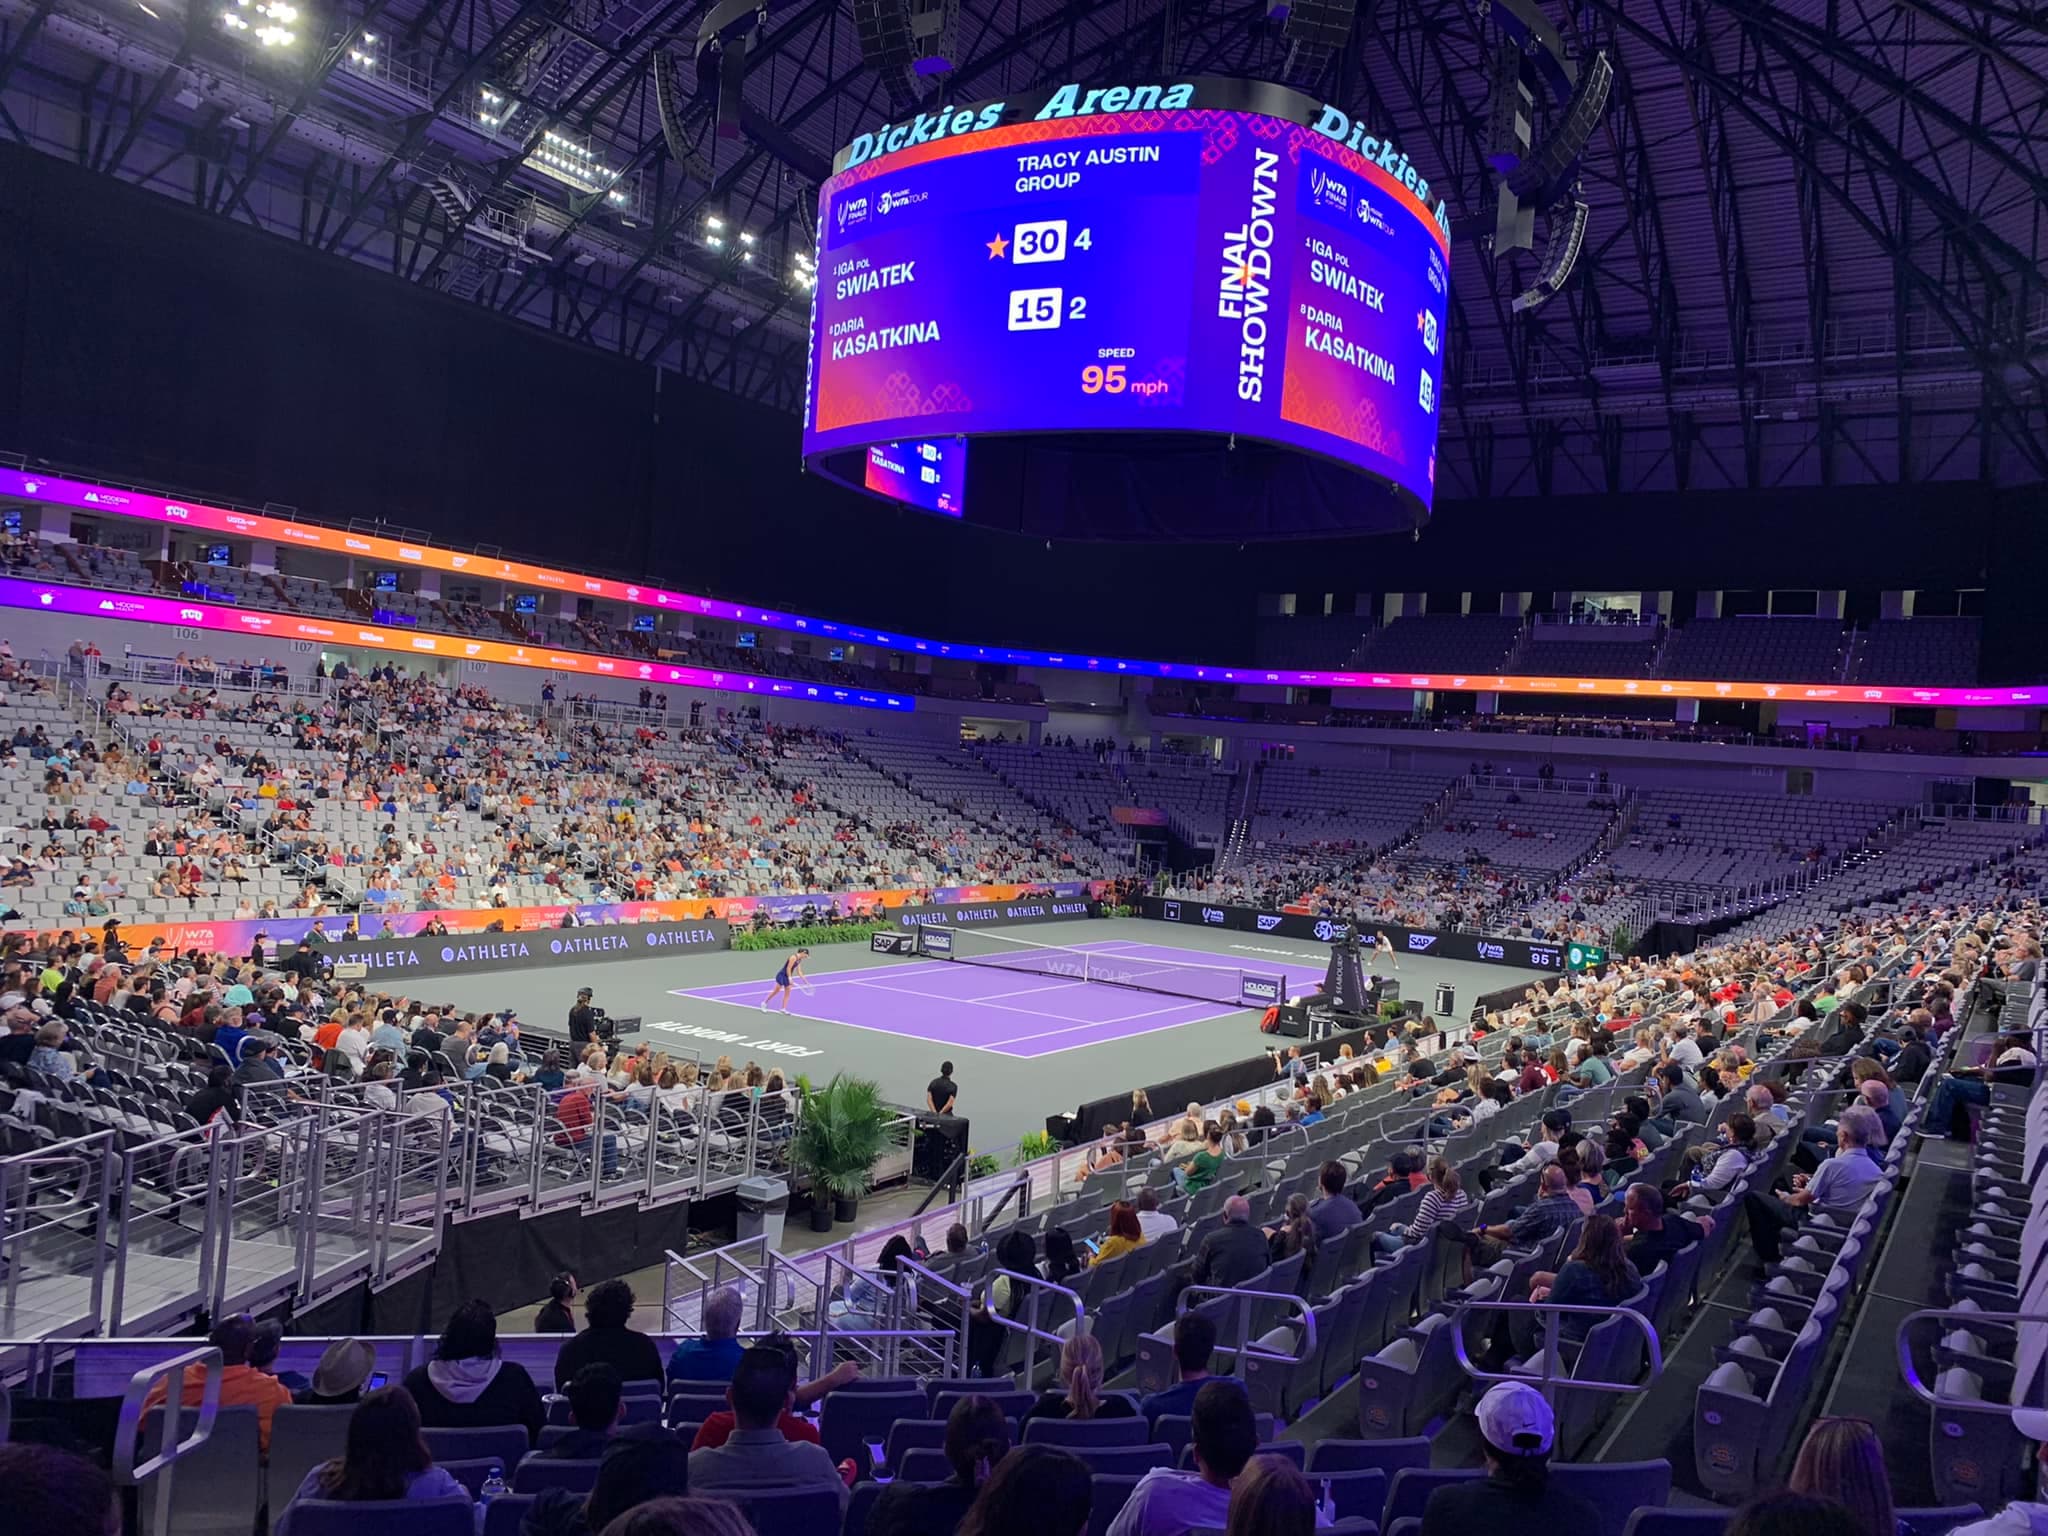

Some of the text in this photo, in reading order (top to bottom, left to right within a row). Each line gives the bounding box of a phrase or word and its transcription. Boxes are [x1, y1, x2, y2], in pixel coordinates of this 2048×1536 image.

[844, 83, 1194, 170] Dickies Arena
[1017, 146, 1160, 172] TRACY AUSTIN
[1312, 103, 1429, 201] Dickies
[1015, 172, 1081, 193] GROUP
[1326, 178, 1347, 197] WTA
[849, 198, 867, 212] WTA
[1020, 228, 1092, 255] 30 4
[1312, 239, 1333, 260] IGA
[1335, 254, 1350, 267] POL
[838, 260, 854, 275] IGA
[856, 258, 870, 269] POL
[1218, 224, 1248, 319] FINAL
[1238, 147, 1279, 402] SHOWDOWN
[836, 261, 916, 300] SWIATEK
[1310, 260, 1385, 313] SWIATEK
[1015, 297, 1087, 323] 15 2
[1307, 306, 1343, 332] DARIA
[833, 317, 864, 337] DARIA
[832, 320, 940, 361] KASATKINA
[1098, 347, 1135, 359] SPEED
[1305, 326, 1395, 385] KASATKINA
[1081, 365, 1168, 396] 95 mph
[165, 505, 188, 519] TCU
[181, 609, 203, 621] TCU
[176, 628, 199, 640] 106
[295, 641, 313, 652] 107
[471, 662, 486, 672] 107
[910, 911, 948, 925] ATHLETA
[963, 908, 998, 921] ATHLETA
[1012, 905, 1045, 917] ATHLETA
[1058, 903, 1088, 914] ATHLETA
[1258, 918, 1275, 928] SAP
[184, 929, 215, 939] WTA
[185, 939, 214, 947] FINALS
[657, 929, 715, 945] ATHLETA
[875, 937, 891, 948] SAP
[1410, 936, 1429, 947] SAP
[457, 942, 530, 962] ATHLETA
[563, 935, 629, 953] ATHLETA
[336, 950, 420, 969] ATHLETA
[1531, 953, 1549, 965] 95
[1046, 960, 1131, 984] WTA TOUR
[1335, 953, 1344, 995] SEABOURN
[1245, 980, 1277, 993] HOLOGIC
[646, 1020, 825, 1057] FORT WORTH
